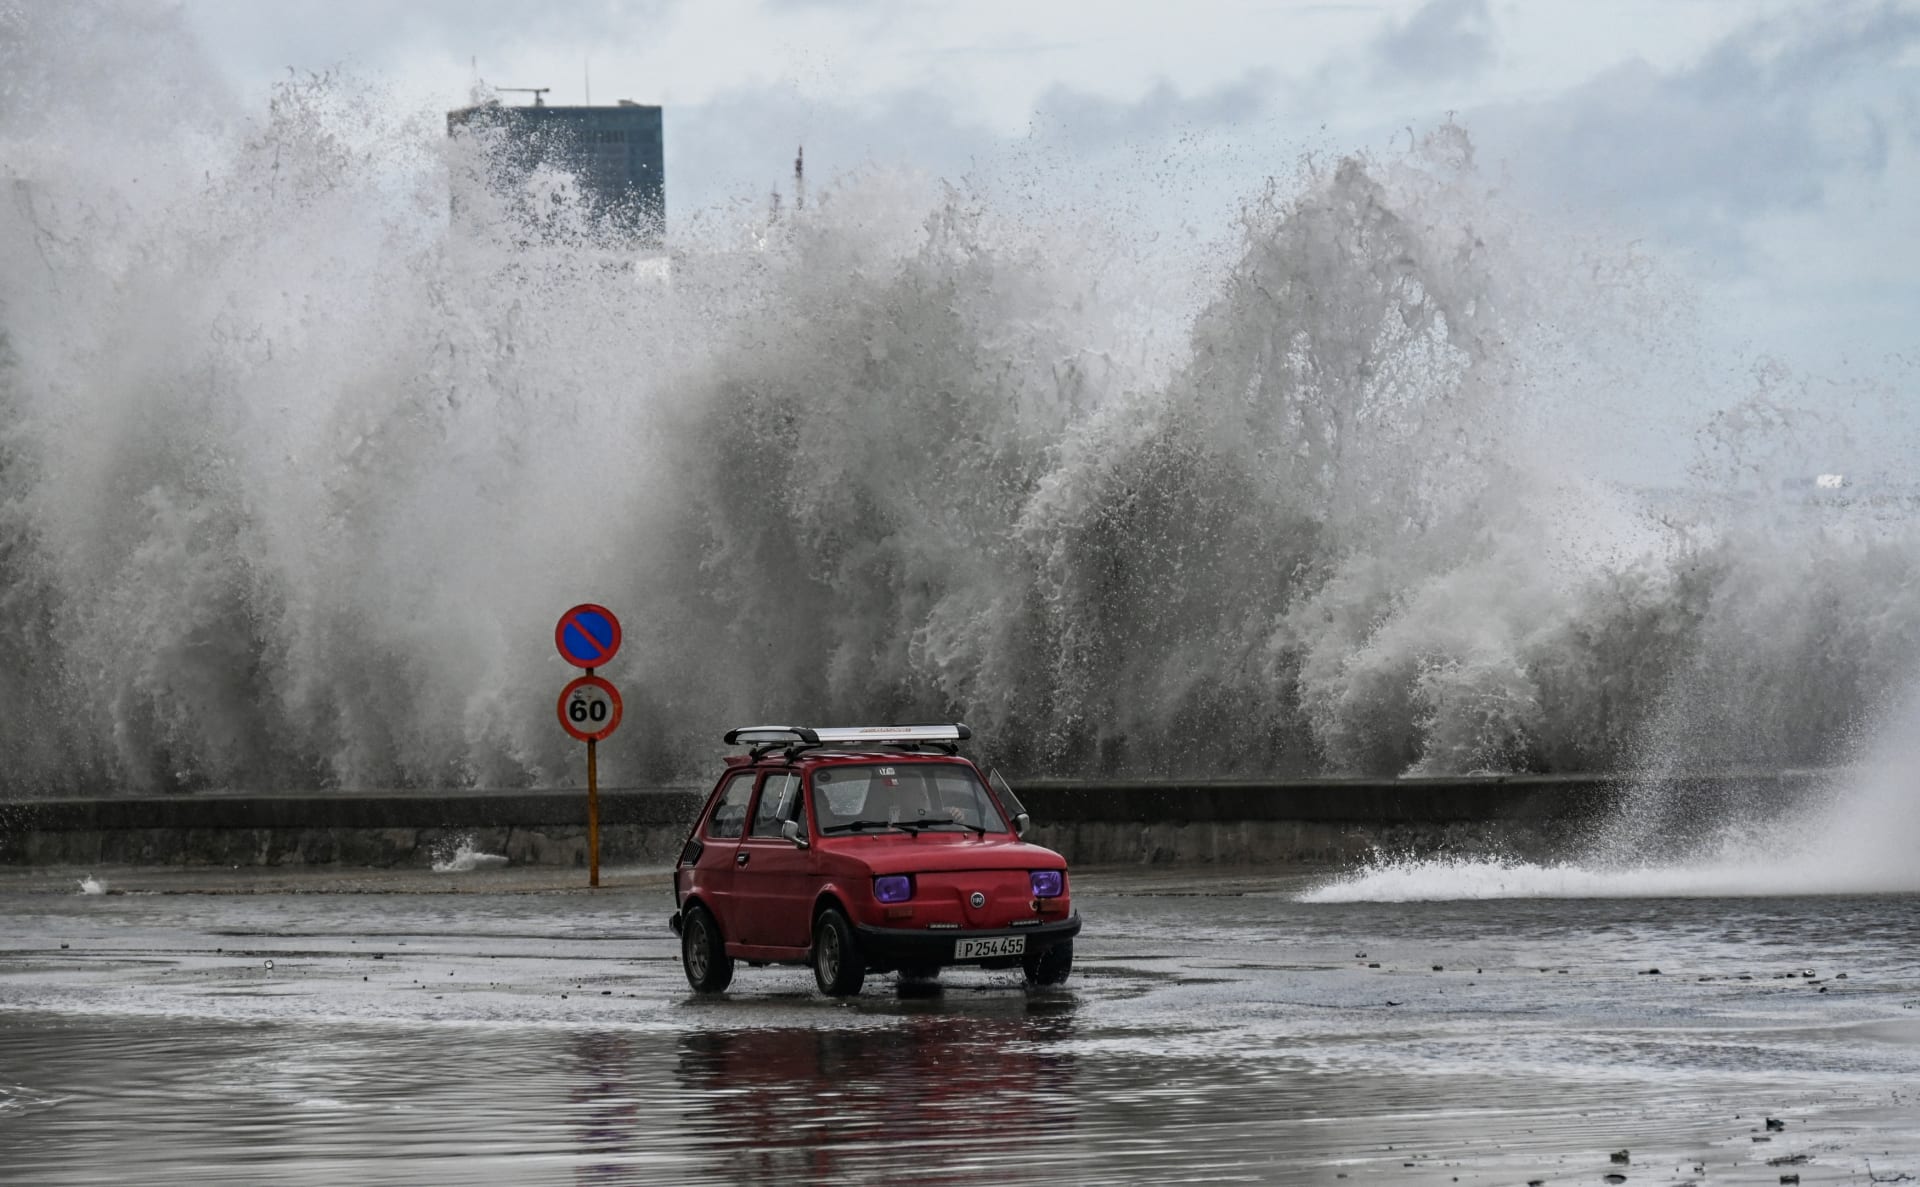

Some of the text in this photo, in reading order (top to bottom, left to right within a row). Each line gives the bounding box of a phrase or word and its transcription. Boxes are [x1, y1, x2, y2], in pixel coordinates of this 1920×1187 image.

[569, 700, 606, 722] 60
[965, 943, 973, 957] P
[975, 941, 998, 956] 254
[1000, 938, 1023, 954] 455
